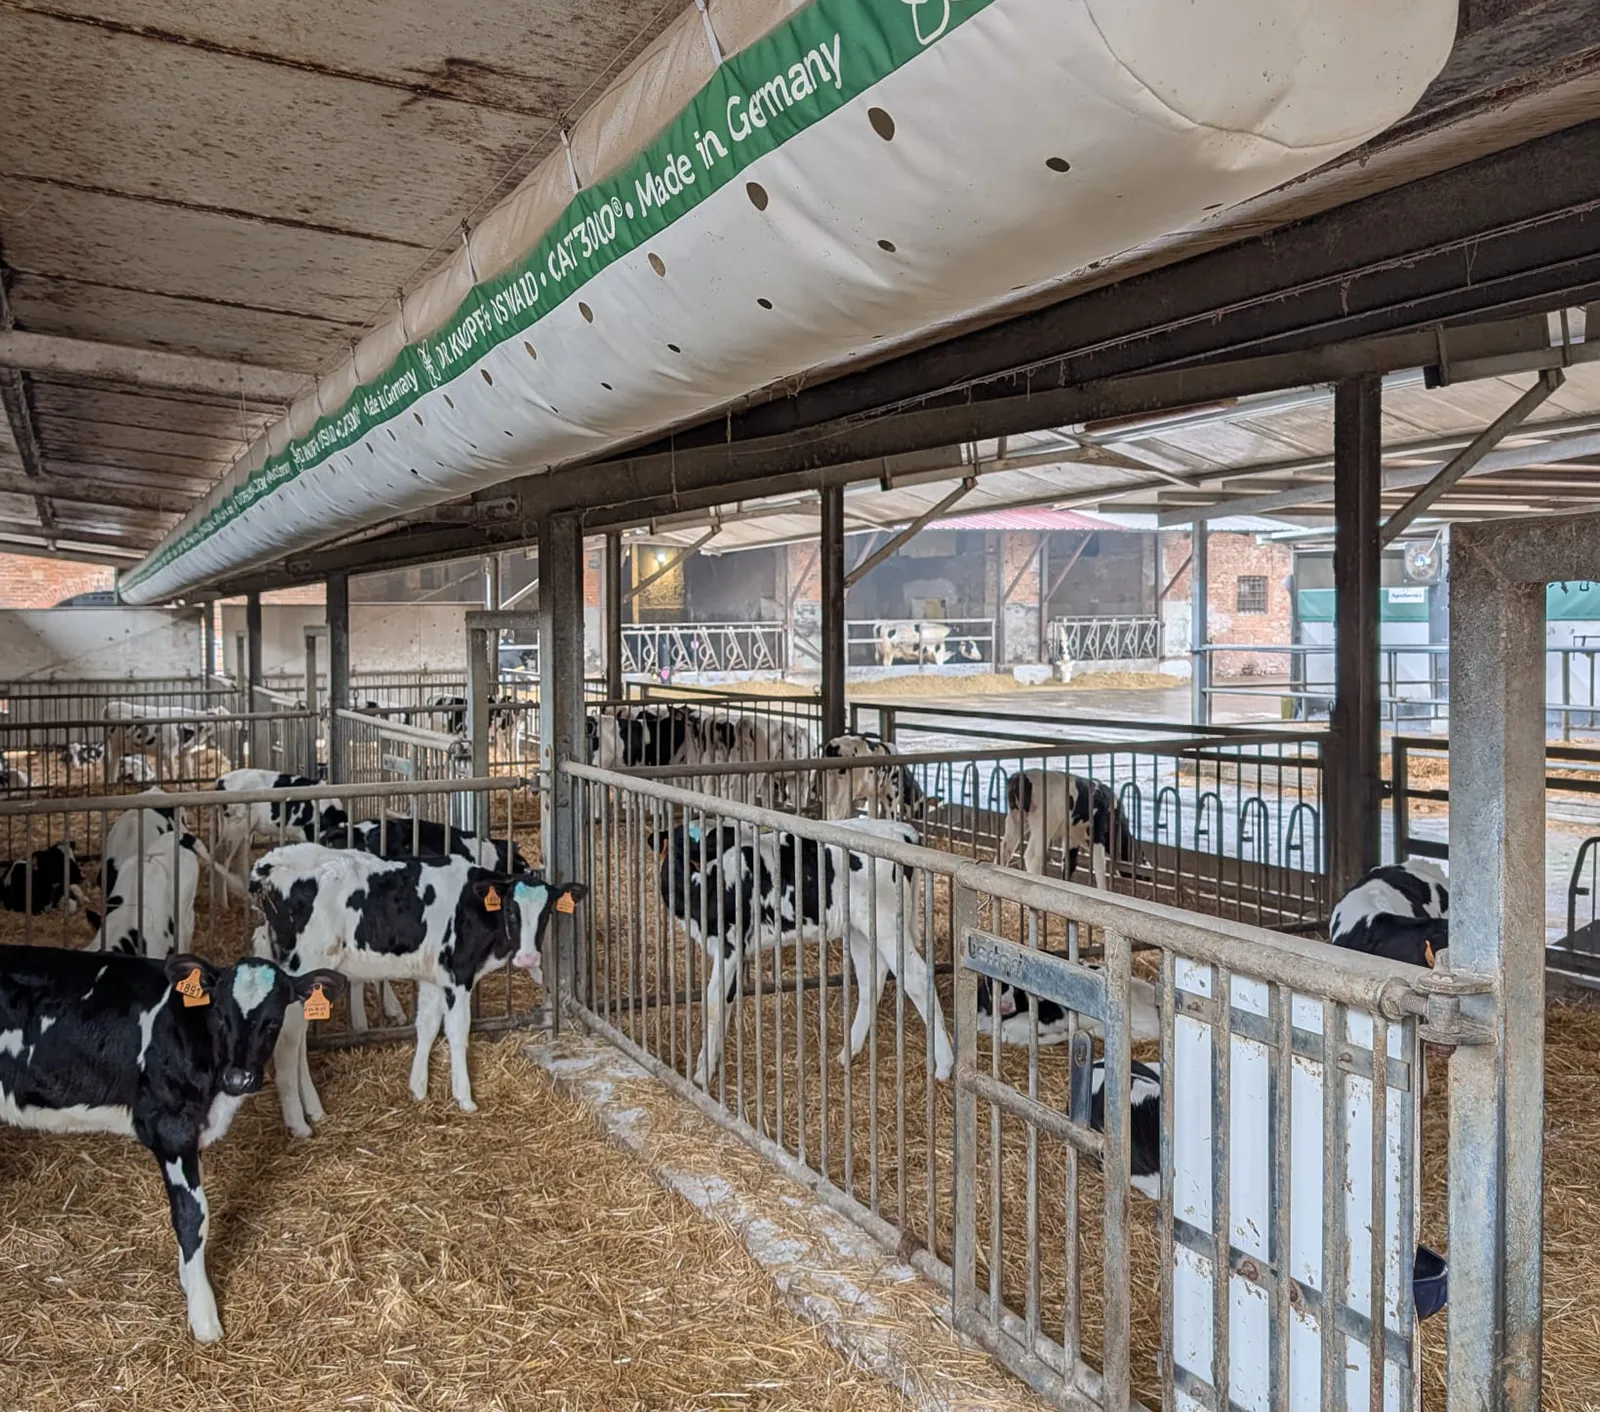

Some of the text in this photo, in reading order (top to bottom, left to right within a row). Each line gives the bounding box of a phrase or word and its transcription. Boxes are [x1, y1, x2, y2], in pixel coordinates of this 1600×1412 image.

[635, 153, 696, 218] Made
[693, 131, 729, 171] in
[726, 32, 843, 142] Germany
[179, 981, 201, 997] 1891
